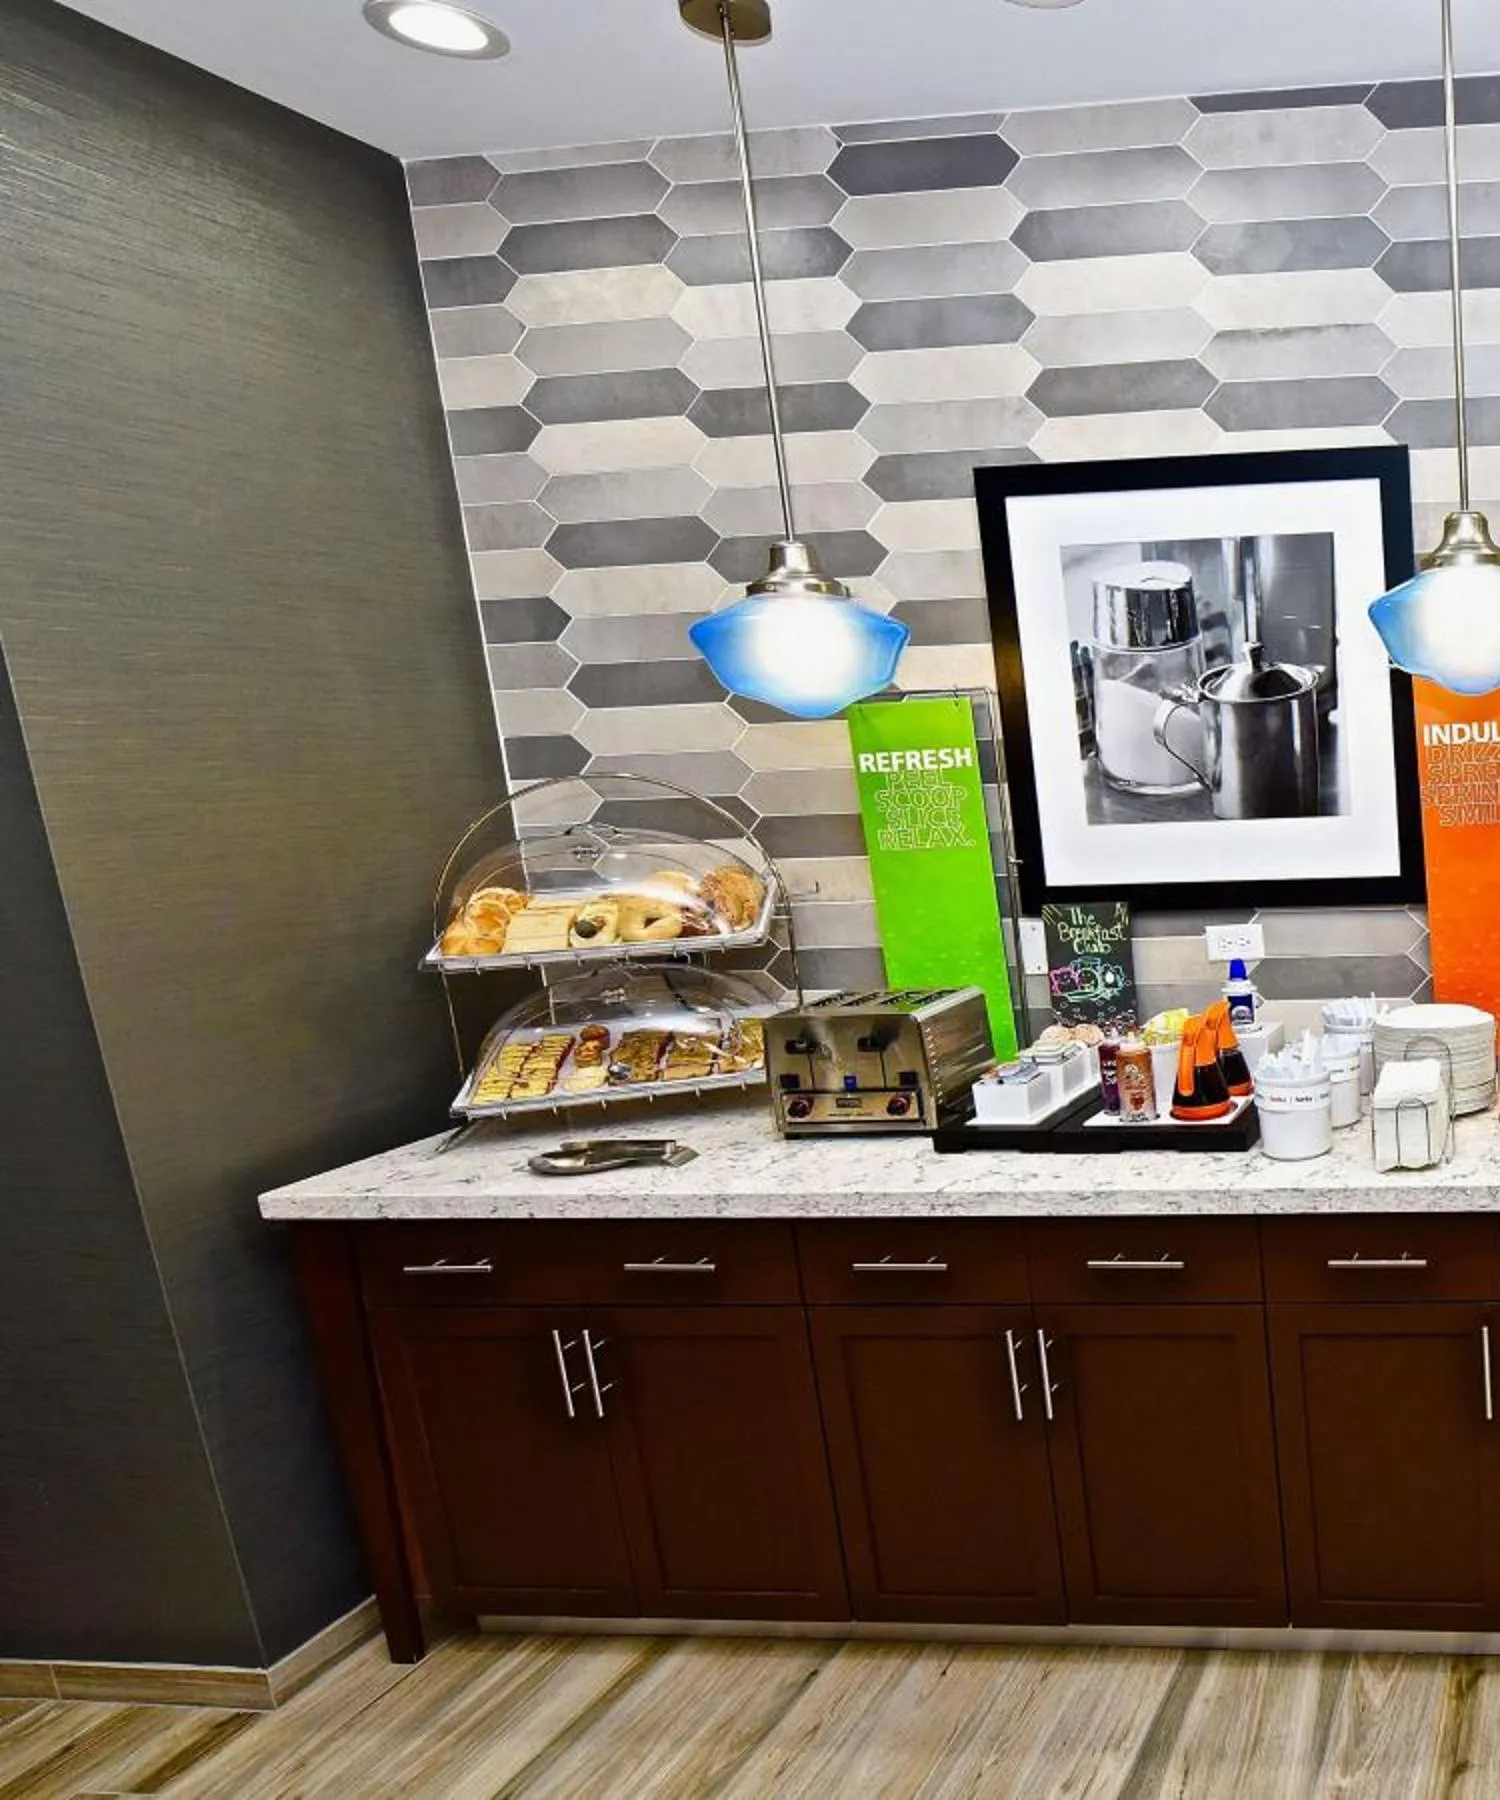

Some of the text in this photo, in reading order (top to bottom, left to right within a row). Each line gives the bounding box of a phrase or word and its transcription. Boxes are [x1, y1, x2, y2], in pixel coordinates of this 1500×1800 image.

[858, 747, 973, 773] REFRESH
[885, 767, 954, 793] PEEL
[874, 785, 968, 813] SCOOP
[886, 804, 963, 832] SLICE
[1063, 905, 1097, 926] The
